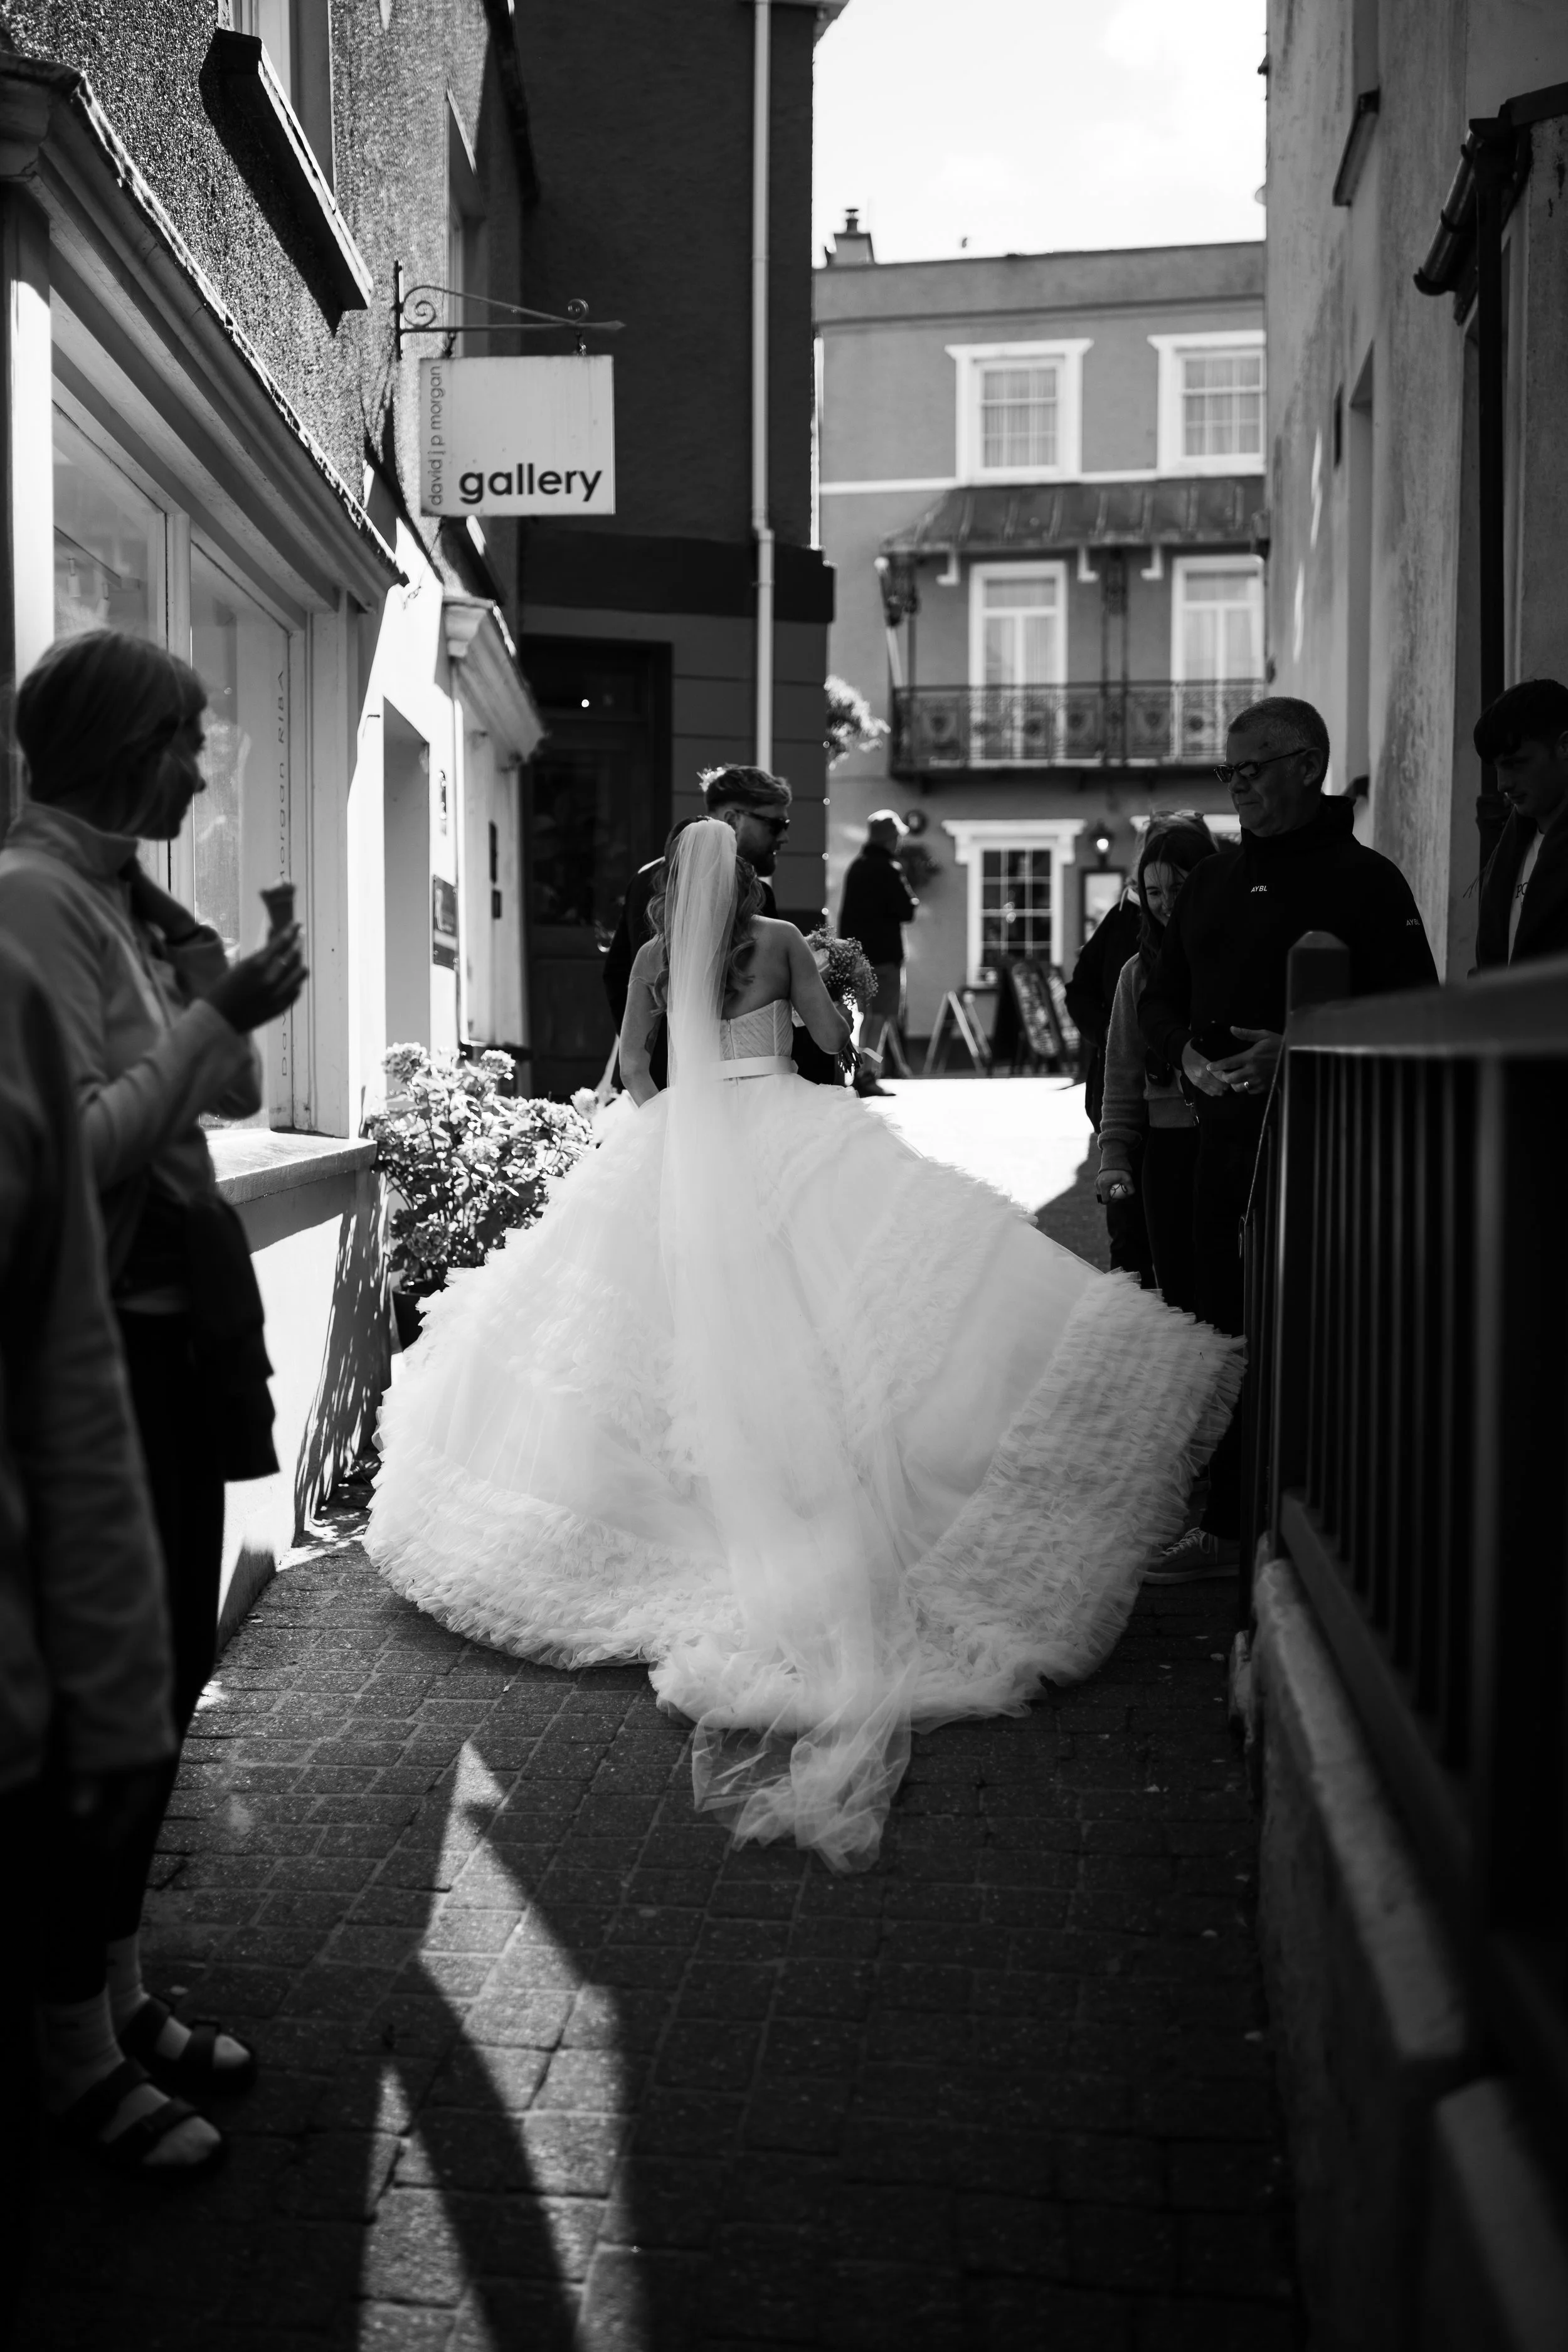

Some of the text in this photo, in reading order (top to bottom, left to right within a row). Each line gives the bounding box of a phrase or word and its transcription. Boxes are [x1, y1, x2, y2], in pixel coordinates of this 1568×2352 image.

[430, 366, 446, 430] morgan
[430, 435, 445, 446] p
[428, 459, 443, 506] david
[458, 463, 602, 504] gallery
[1251, 885, 1268, 893] AYBL
[1406, 918, 1421, 926] AYBL
